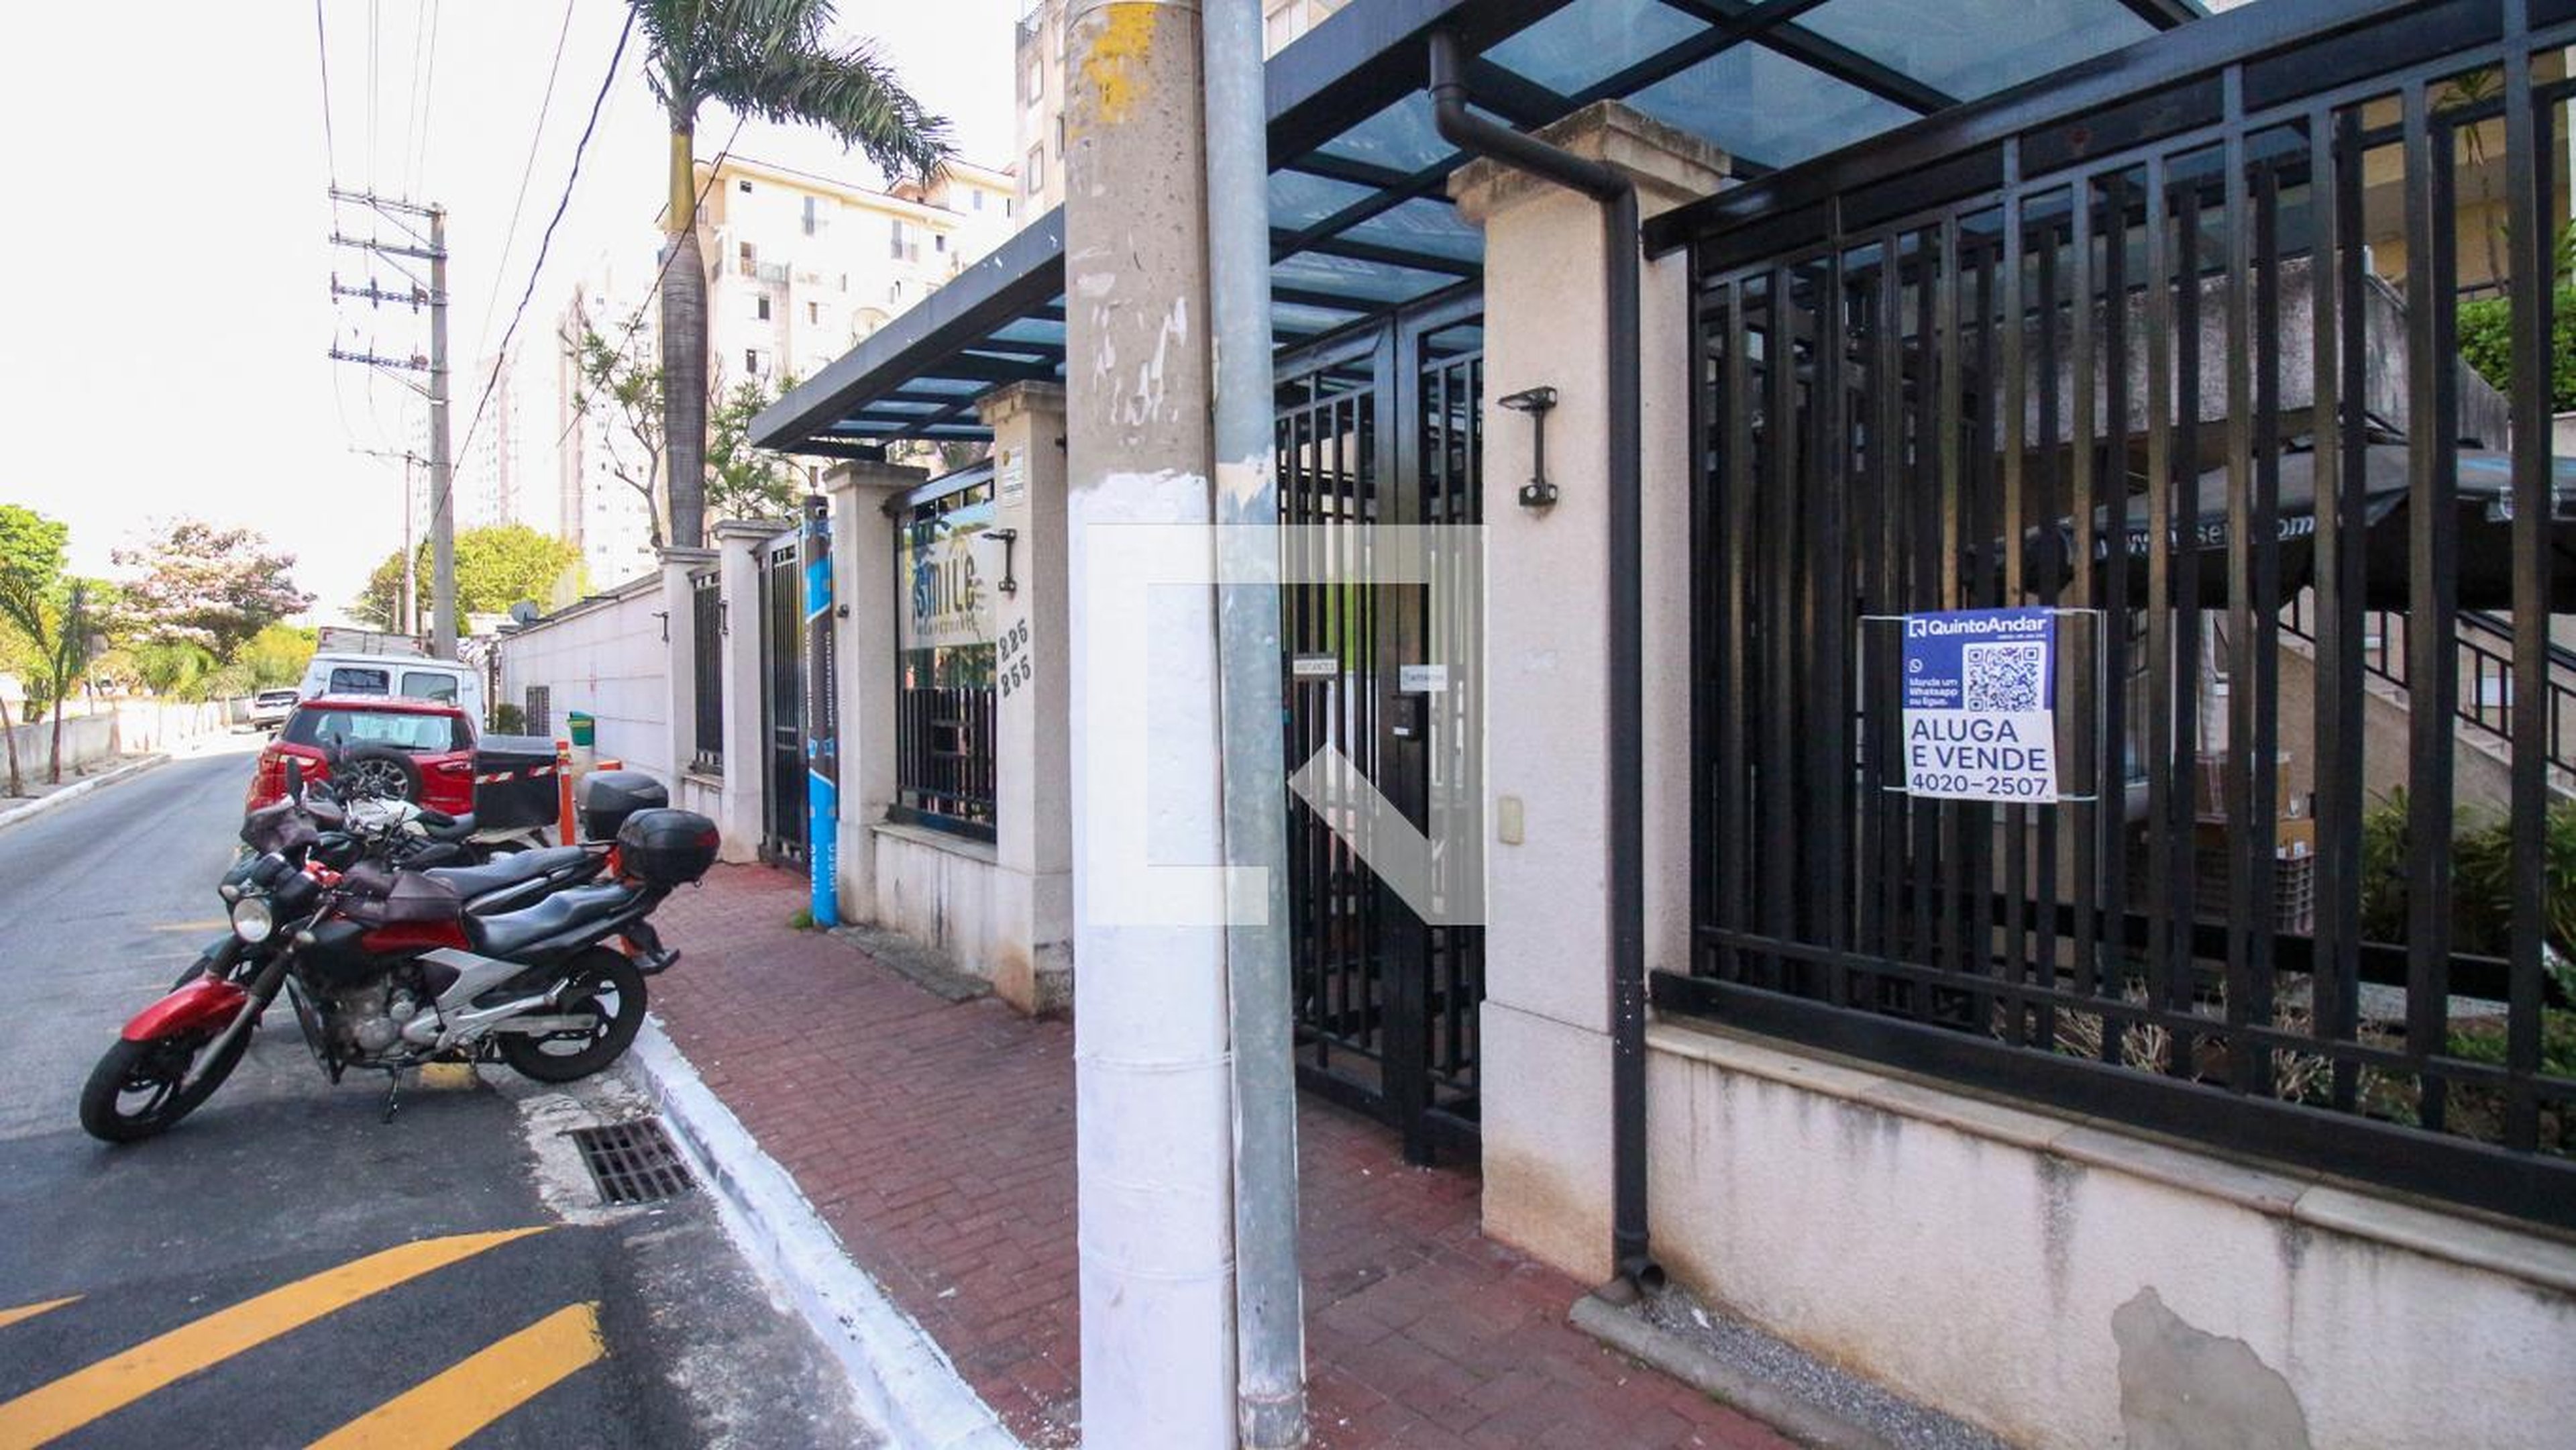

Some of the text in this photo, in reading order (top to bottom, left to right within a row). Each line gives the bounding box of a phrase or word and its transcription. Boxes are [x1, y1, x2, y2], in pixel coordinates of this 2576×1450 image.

[1929, 616, 2046, 635] QuintoAndar
[1000, 619, 1028, 662] 225
[1001, 655, 1031, 698] 255
[1911, 719, 2018, 742] ALUGA
[1913, 745, 2047, 772] E VENDE
[1912, 774, 2047, 796] 4020-2507
